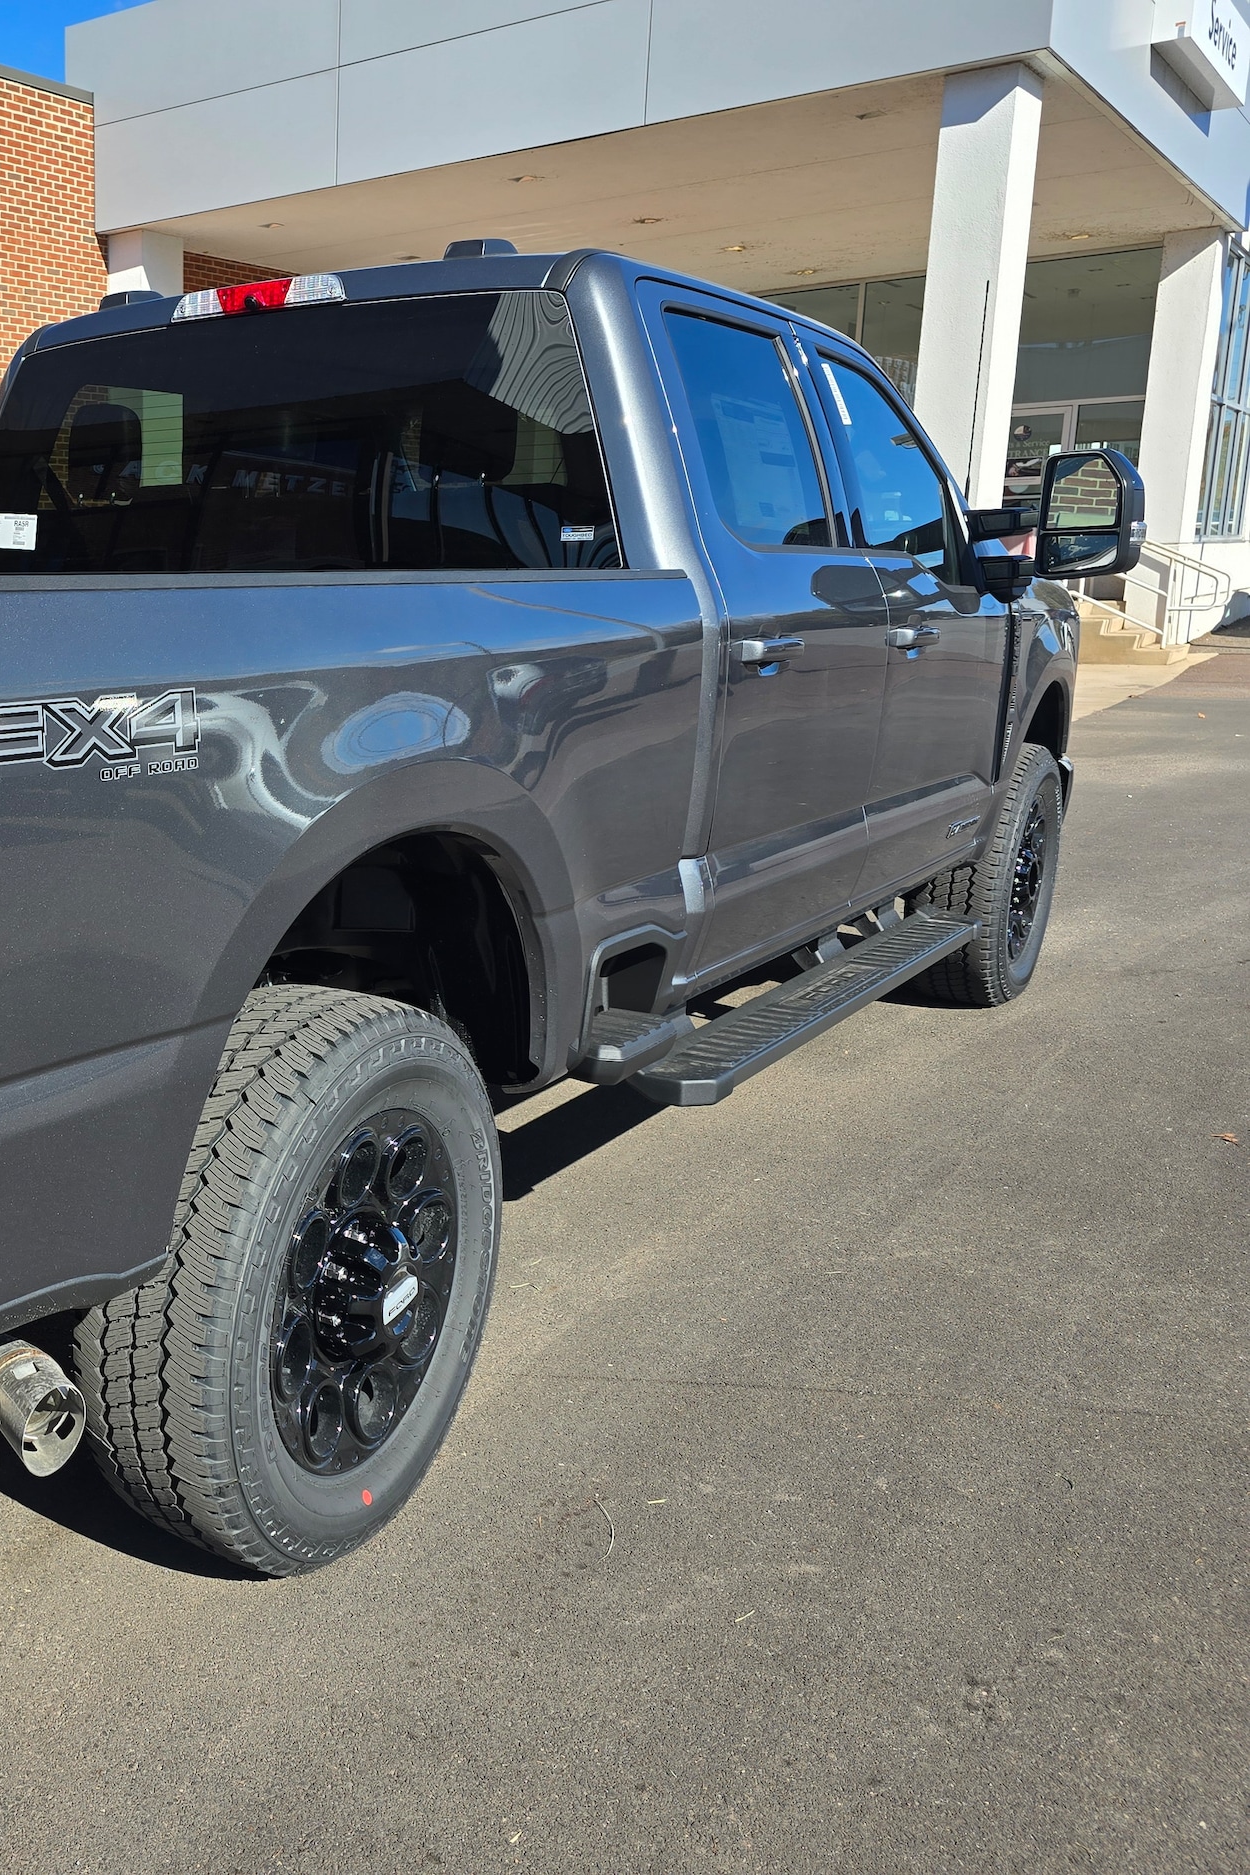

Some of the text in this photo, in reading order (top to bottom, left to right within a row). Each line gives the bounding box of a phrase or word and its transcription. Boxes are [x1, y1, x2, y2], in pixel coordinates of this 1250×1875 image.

[1208, 0, 1237, 70] Service
[231, 468, 347, 497] METZE
[100, 757, 199, 782] OFF ROAD
